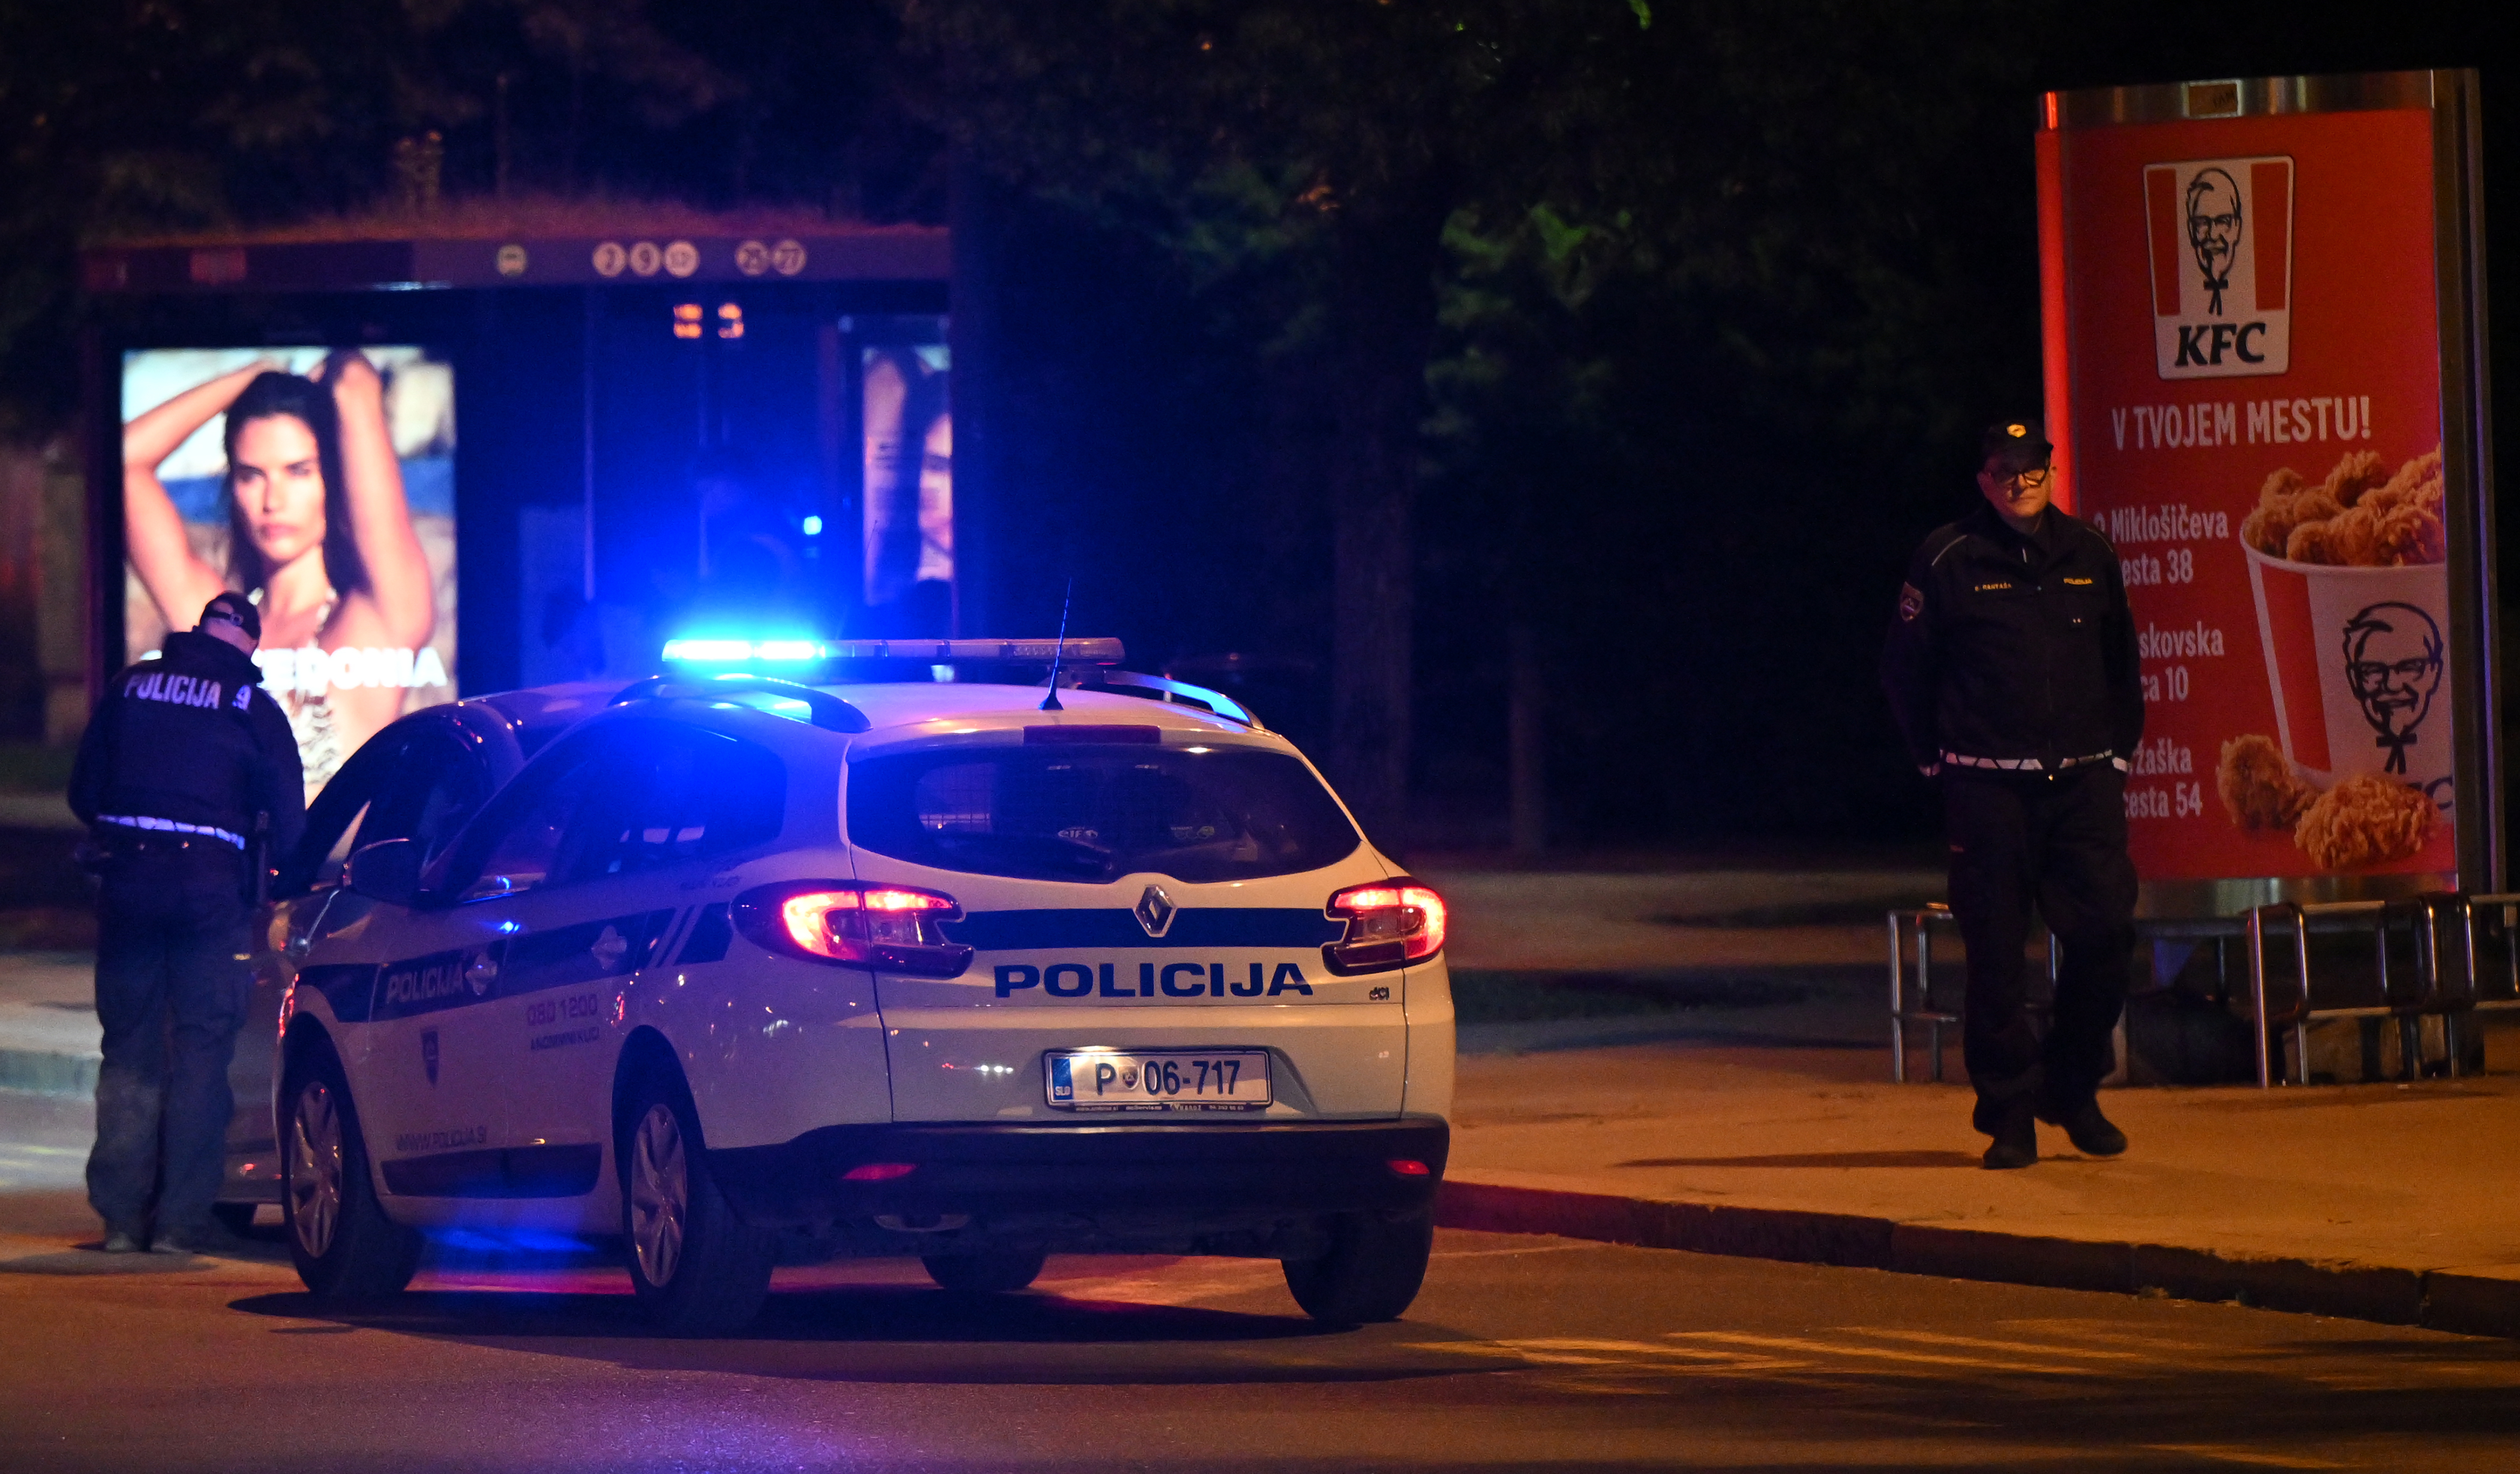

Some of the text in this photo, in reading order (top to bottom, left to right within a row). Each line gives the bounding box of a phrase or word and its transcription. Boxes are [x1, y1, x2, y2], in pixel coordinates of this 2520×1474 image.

[2174, 322, 2266, 367] KFC
[2111, 395, 2371, 451] V TVOJEM MESTU!
[2111, 503, 2230, 544] Miklošičeva
[2121, 547, 2194, 586] esta 38
[2138, 620, 2225, 658] skovska
[124, 671, 222, 710] POLICIJA
[2165, 665, 2189, 702] 10
[2128, 737, 2193, 776] žaška
[2175, 781, 2202, 819] 54
[385, 961, 464, 1006] POLICIJA
[993, 962, 1314, 998] POLICIJA
[527, 993, 598, 1026] 080 1200
[1054, 1085, 1071, 1096] SLO
[1095, 1059, 1241, 1096] P 06-717
